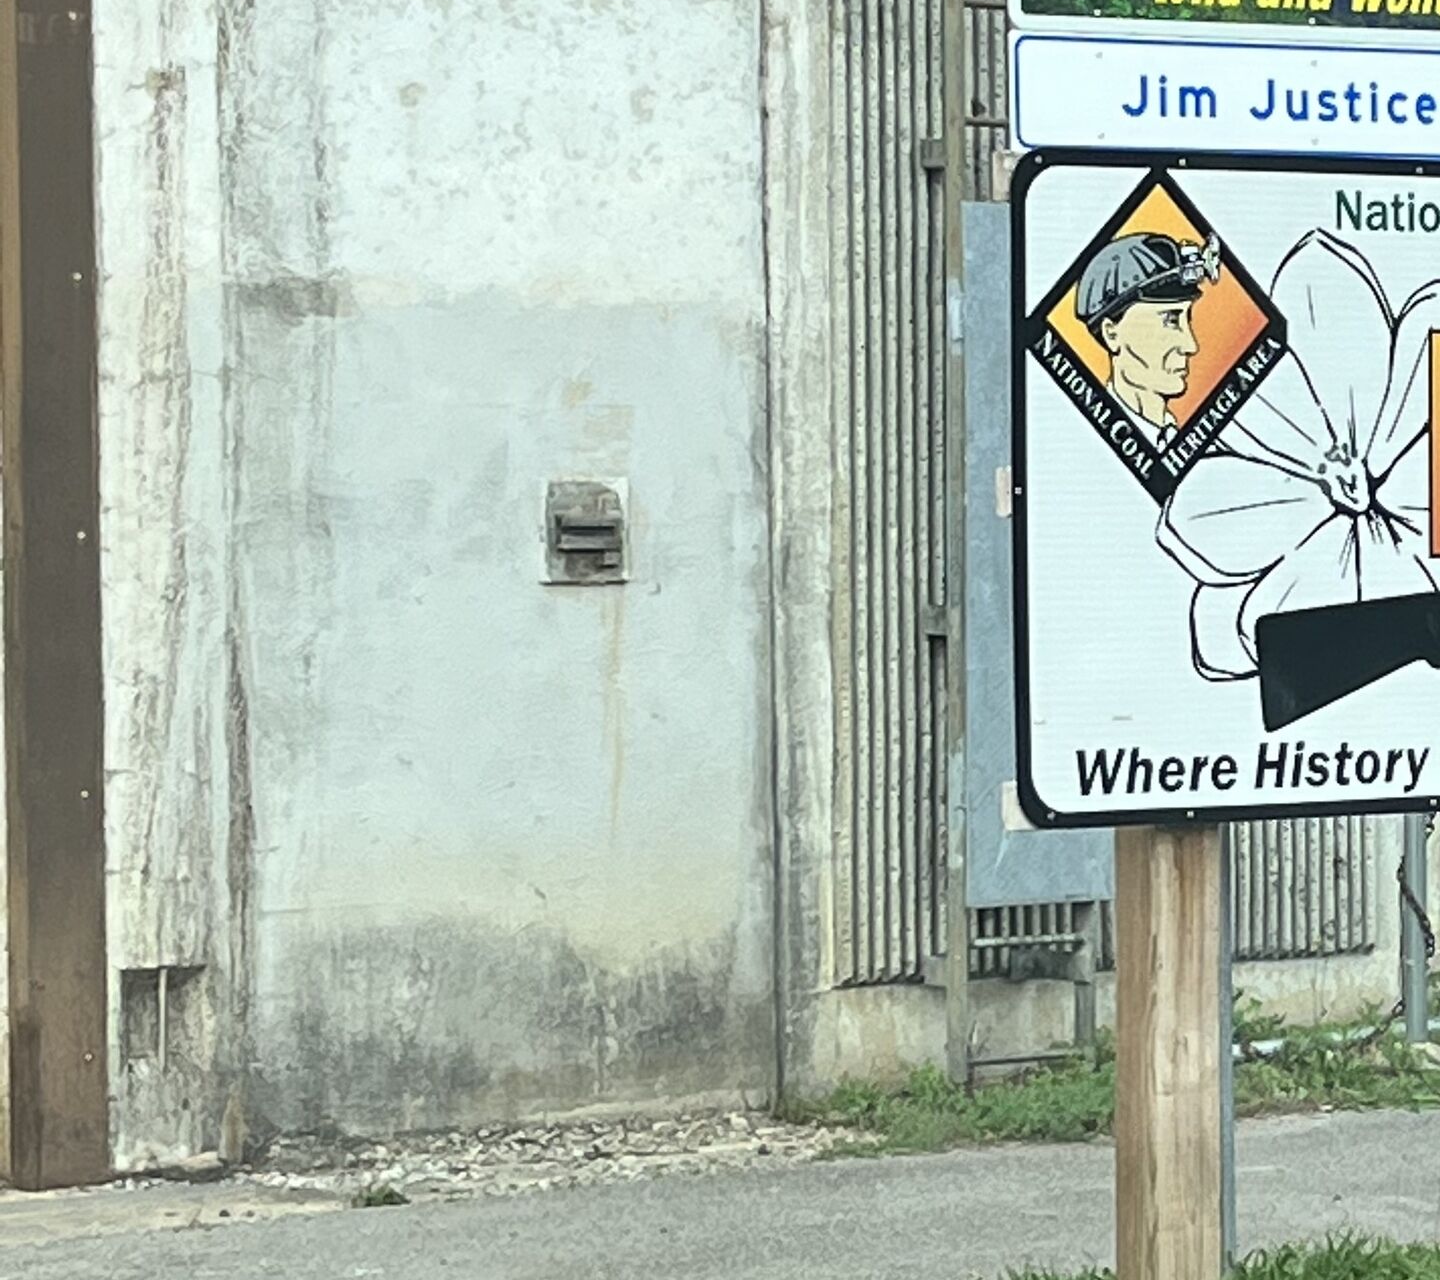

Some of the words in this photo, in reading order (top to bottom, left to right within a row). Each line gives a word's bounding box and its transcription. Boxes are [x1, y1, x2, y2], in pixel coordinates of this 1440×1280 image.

[1122, 75, 1217, 118] Jim
[1034, 329, 1110, 428] NATIONAL
[1109, 420, 1155, 480] COAL
[1160, 384, 1242, 477] HERITAGE
[1235, 337, 1282, 392] AREA
[1076, 746, 1239, 796] Where
[1254, 740, 1431, 793] History
